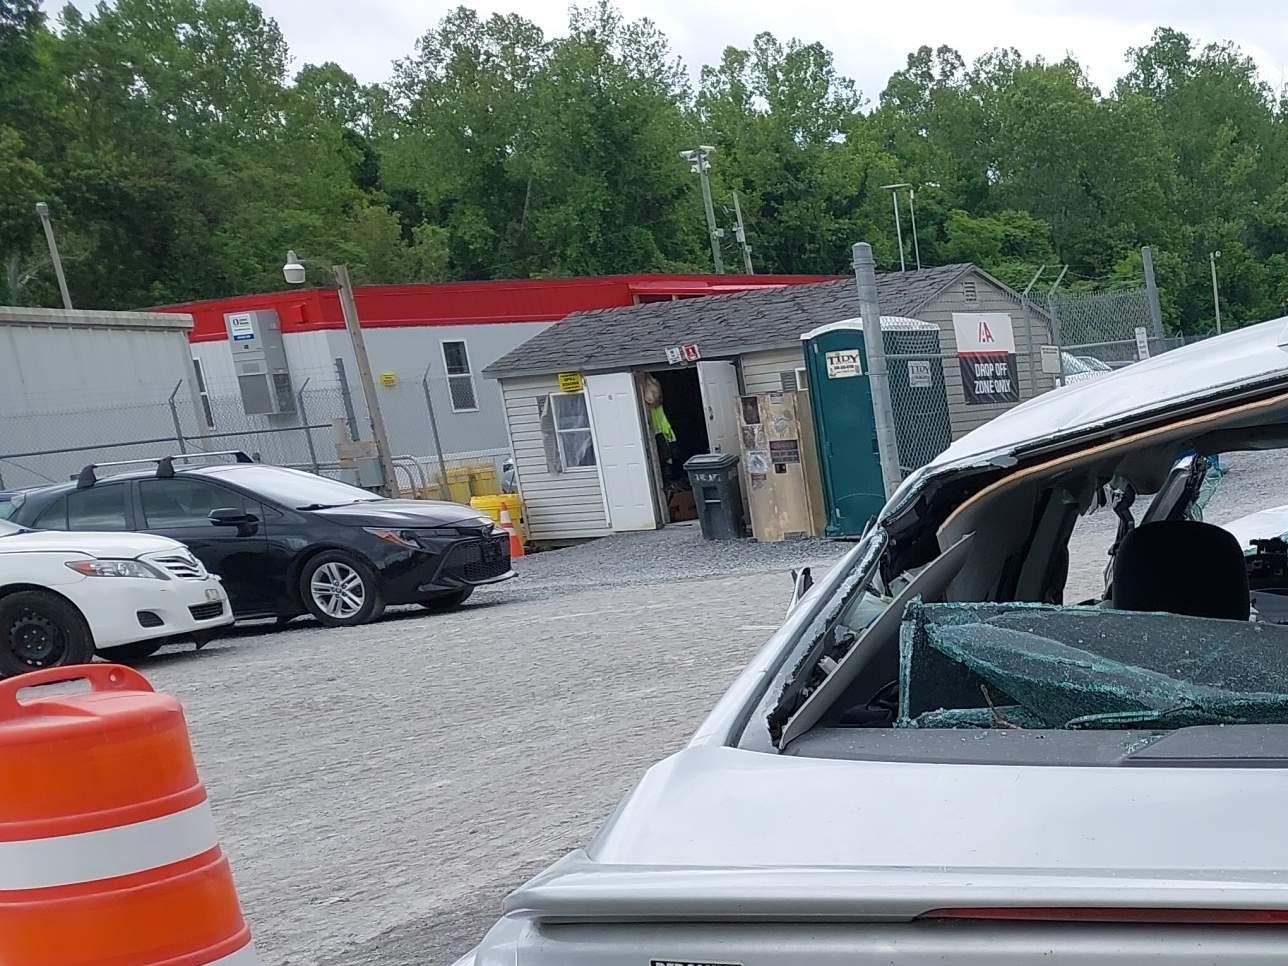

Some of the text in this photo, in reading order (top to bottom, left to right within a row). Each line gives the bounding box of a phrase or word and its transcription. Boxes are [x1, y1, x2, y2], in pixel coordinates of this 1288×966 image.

[827, 354, 859, 365] TIDY
[974, 362, 1008, 377] DROP OFF
[974, 379, 1011, 395] ZONE ONLY
